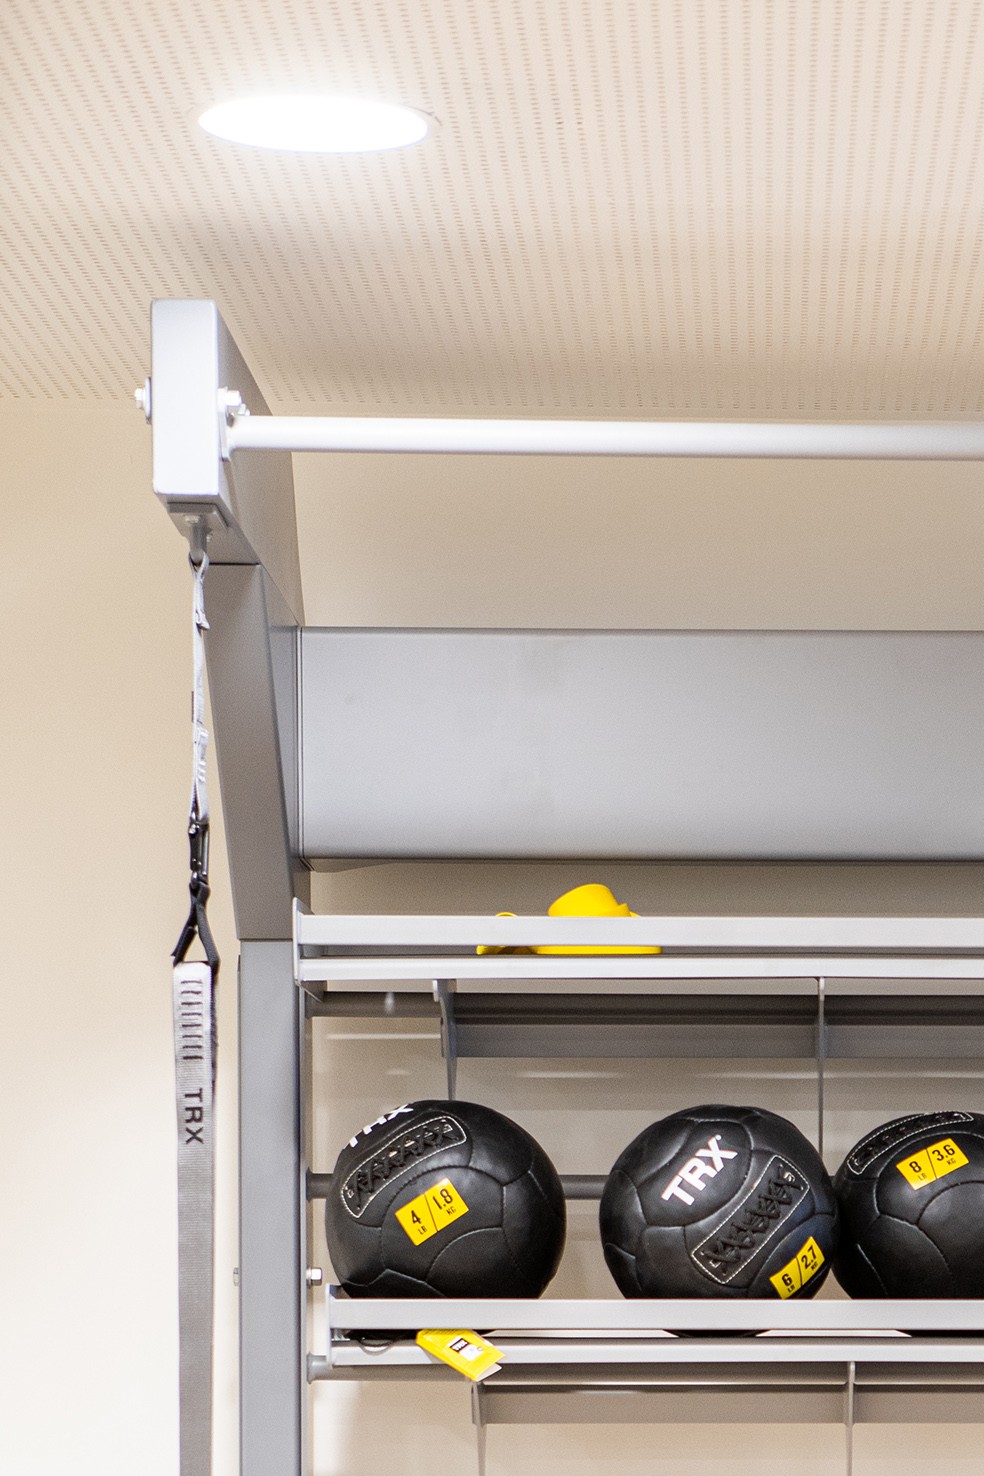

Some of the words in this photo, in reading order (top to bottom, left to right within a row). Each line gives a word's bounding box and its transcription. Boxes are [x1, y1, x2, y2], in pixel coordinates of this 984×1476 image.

[185, 1087, 204, 1145] TRX
[661, 1134, 738, 1206] TRX
[908, 1160, 922, 1173] 8
[931, 1144, 956, 1162] 3.6
[917, 1172, 928, 1182] LB
[946, 1157, 957, 1166] KG
[411, 1209, 422, 1224] 4
[432, 1188, 454, 1210] 1.8
[417, 1225, 428, 1236] LB
[446, 1206, 457, 1217] KG
[781, 1273, 793, 1287] 6
[801, 1244, 817, 1270] 2.7
